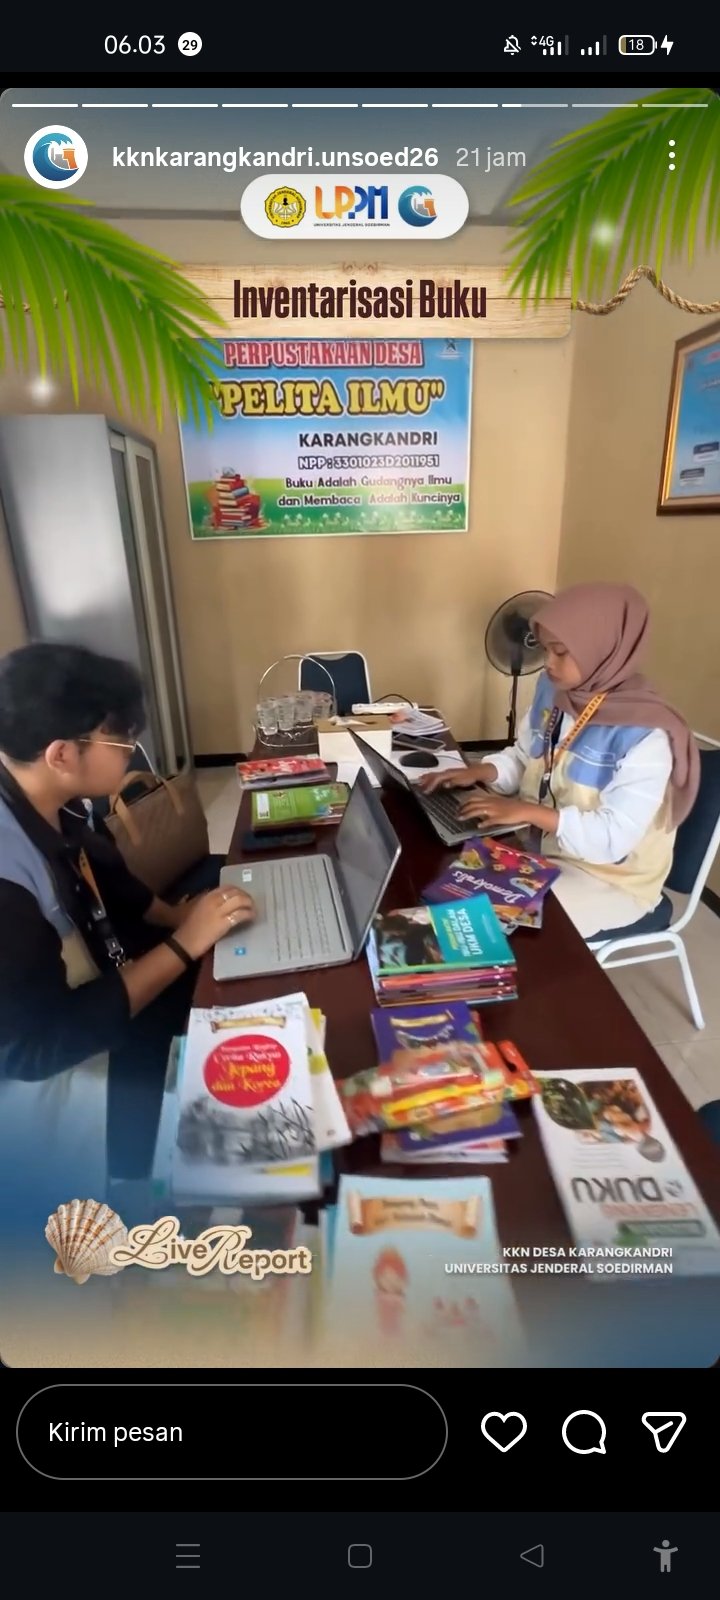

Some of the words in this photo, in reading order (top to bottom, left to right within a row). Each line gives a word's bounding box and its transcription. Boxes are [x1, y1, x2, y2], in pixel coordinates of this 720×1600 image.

[224, 340, 371, 367] PERPUSTAKAAN
[374, 340, 424, 367] DESA
[299, 431, 438, 448] KARANGKANDRI
[285, 477, 313, 488] Buku
[317, 478, 357, 488] Adalah
[361, 476, 424, 491] Gudangnya
[428, 475, 452, 486] Ilmu
[278, 496, 300, 507] dan
[304, 495, 361, 506] Membaca
[369, 493, 407, 505] Adalah
[411, 493, 460, 507] Kuncinya
[456, 908, 474, 933] DESA
[571, 1177, 664, 1203] DUKU
